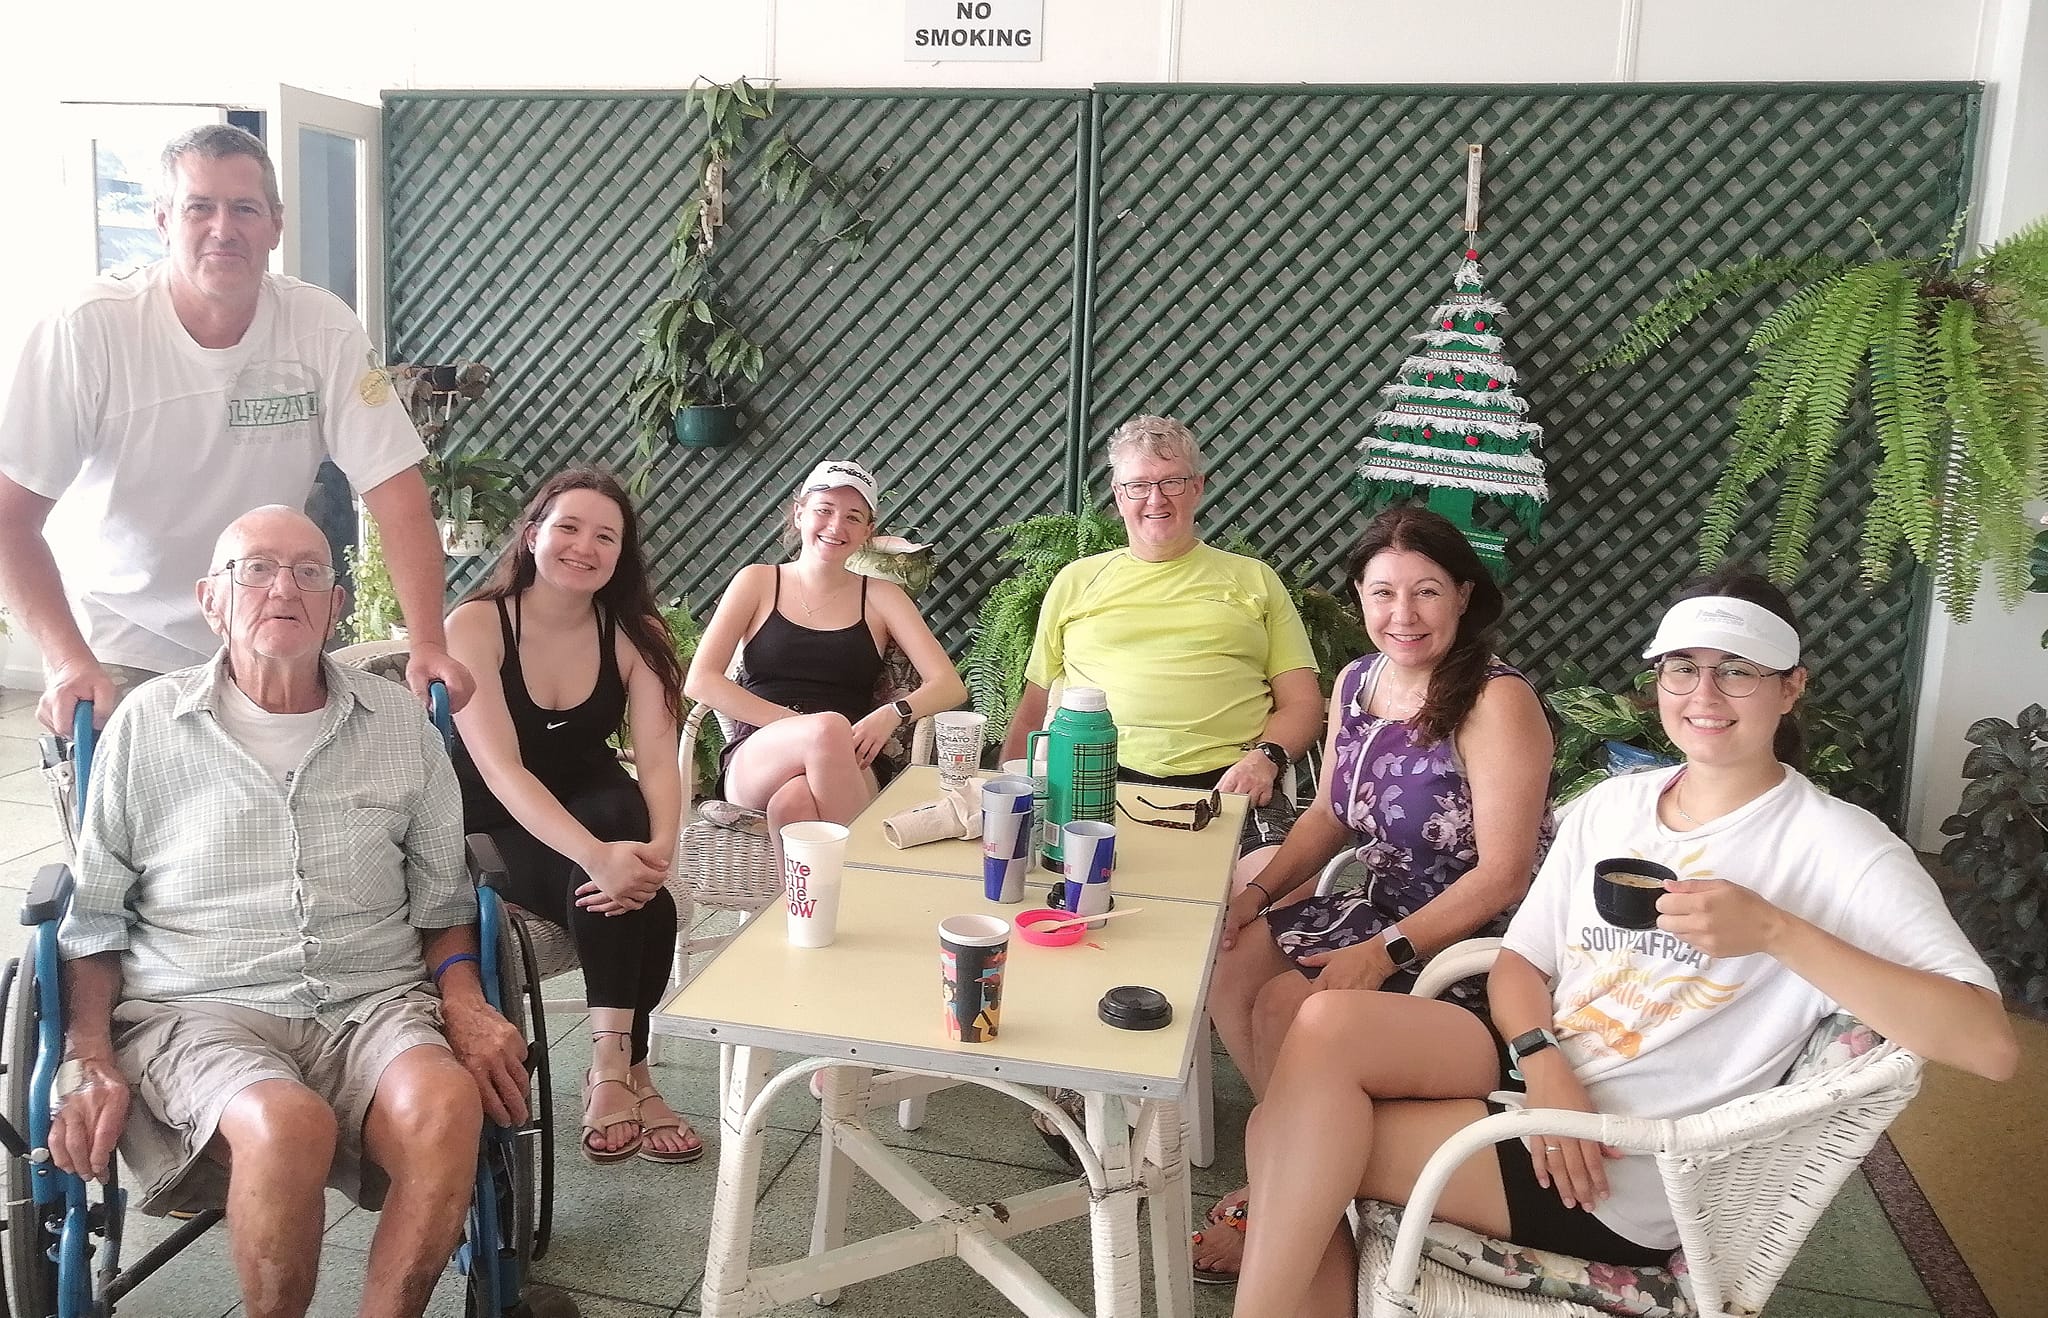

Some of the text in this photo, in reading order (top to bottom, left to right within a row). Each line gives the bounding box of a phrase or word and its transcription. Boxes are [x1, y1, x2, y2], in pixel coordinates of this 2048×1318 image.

[957, 2, 992, 19] NO
[915, 29, 1032, 47] SMOKING
[786, 853, 811, 877] ive
[788, 887, 808, 902] he
